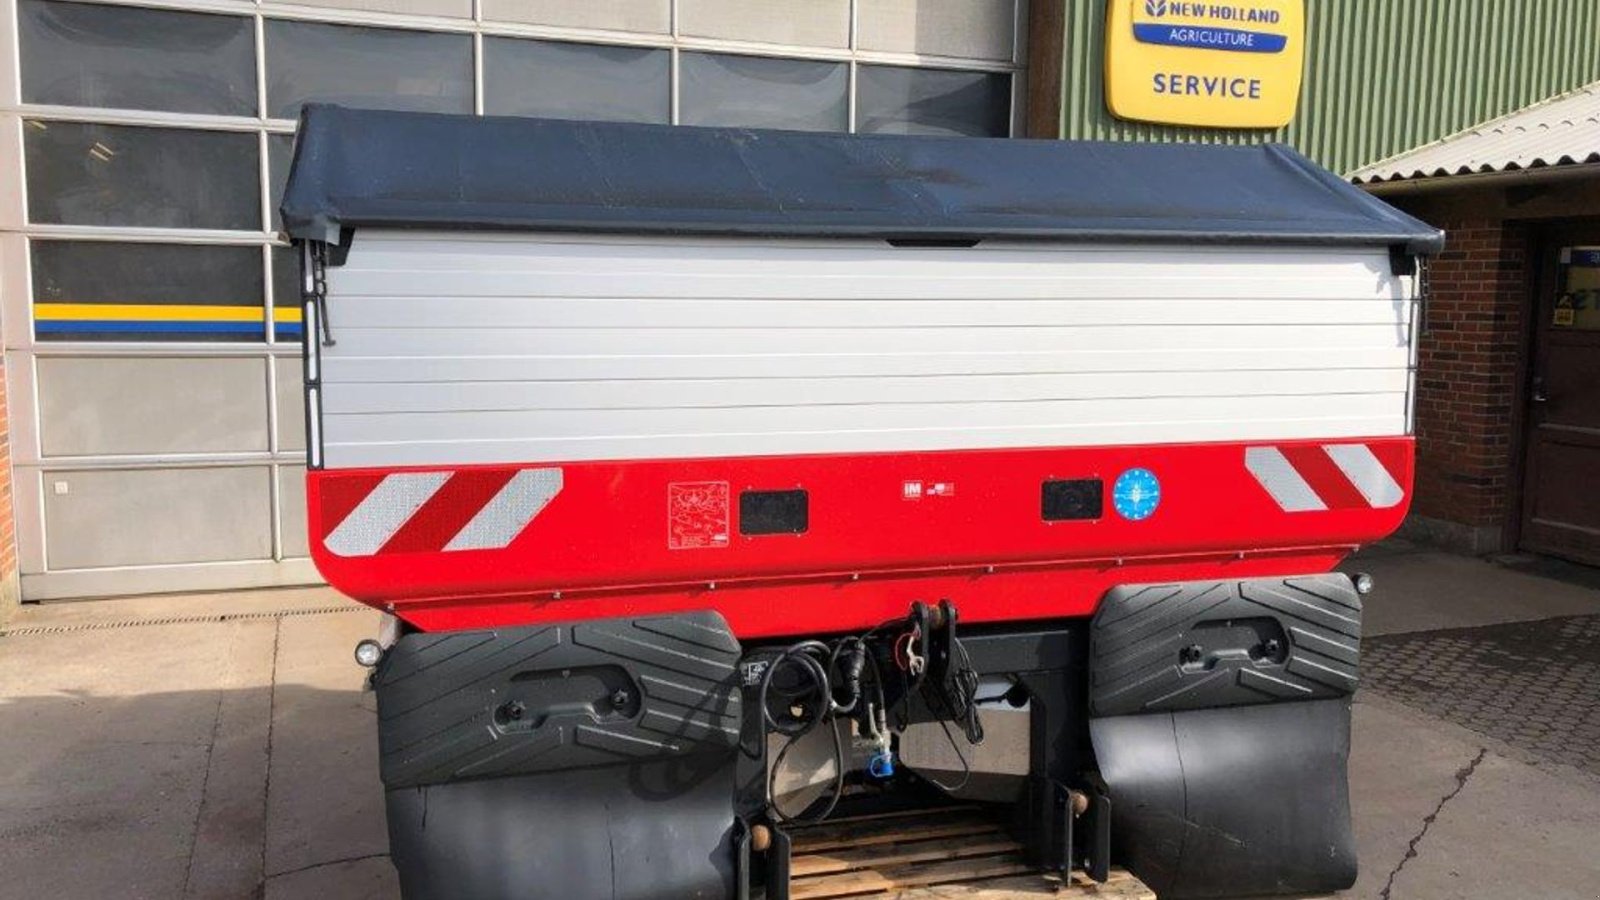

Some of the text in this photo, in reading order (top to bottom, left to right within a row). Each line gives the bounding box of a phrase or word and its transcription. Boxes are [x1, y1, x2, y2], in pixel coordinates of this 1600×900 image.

[1170, 3, 1280, 24] NEW HOLLAND
[1169, 28, 1254, 46] AGRICULTURE
[1153, 73, 1261, 99] SERVICE
